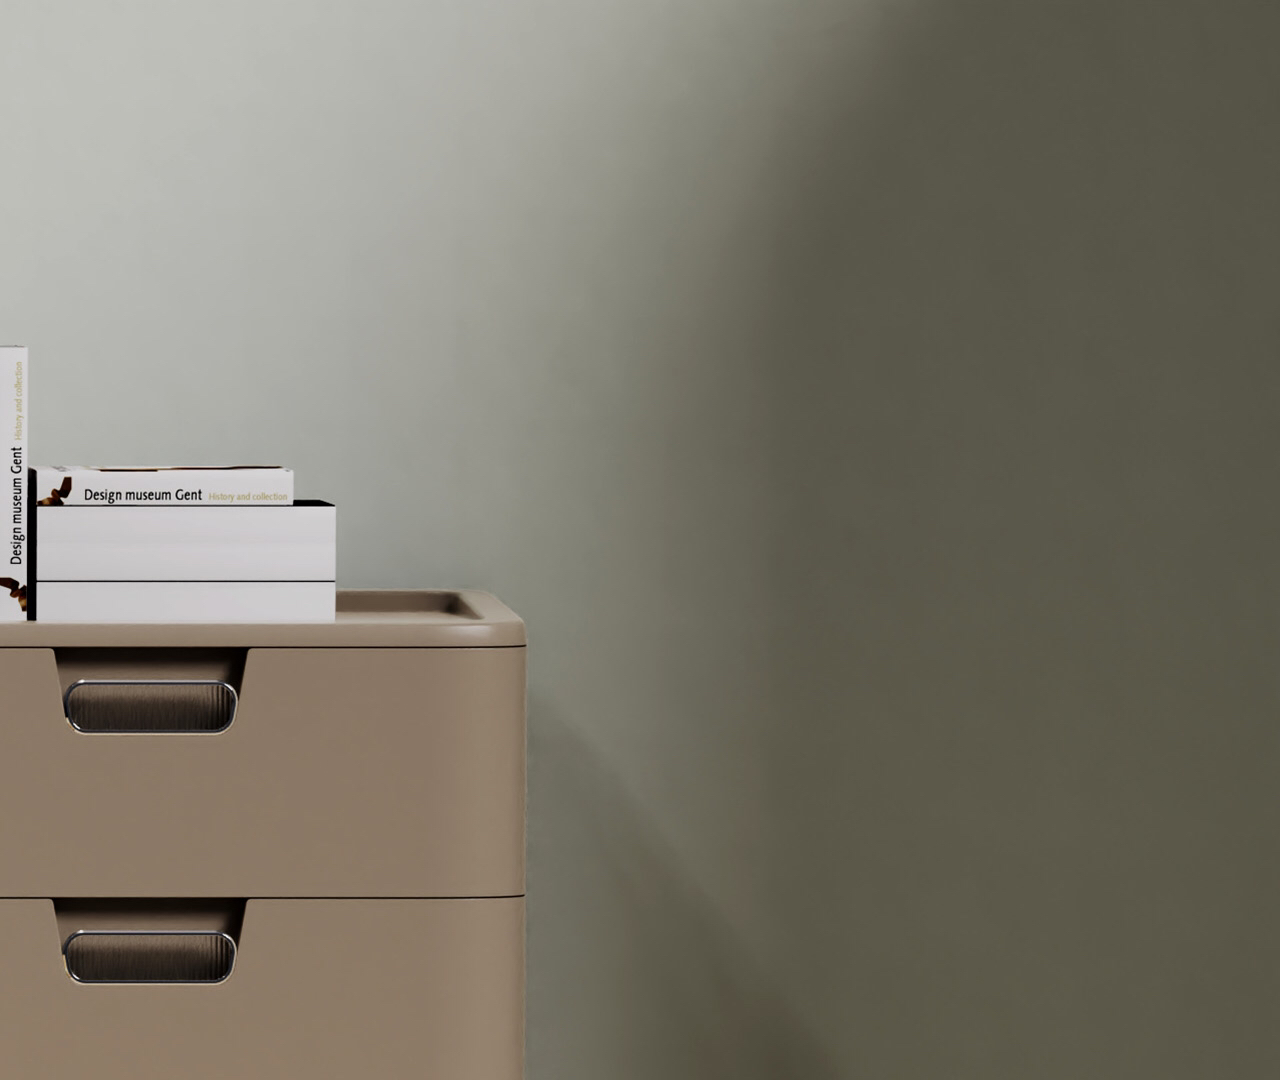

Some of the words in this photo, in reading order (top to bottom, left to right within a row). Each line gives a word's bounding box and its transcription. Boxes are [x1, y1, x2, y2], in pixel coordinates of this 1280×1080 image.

[14, 361, 22, 396] collection
[14, 398, 22, 412] and
[14, 415, 24, 440] History
[11, 447, 22, 474] Gent
[13, 478, 22, 523] museum
[84, 488, 122, 504] Design
[125, 491, 172, 501] museum
[175, 489, 203, 501] Gent
[208, 492, 234, 503] History
[236, 493, 250, 501] and
[252, 493, 288, 501] collection
[10, 527, 25, 564] Design
